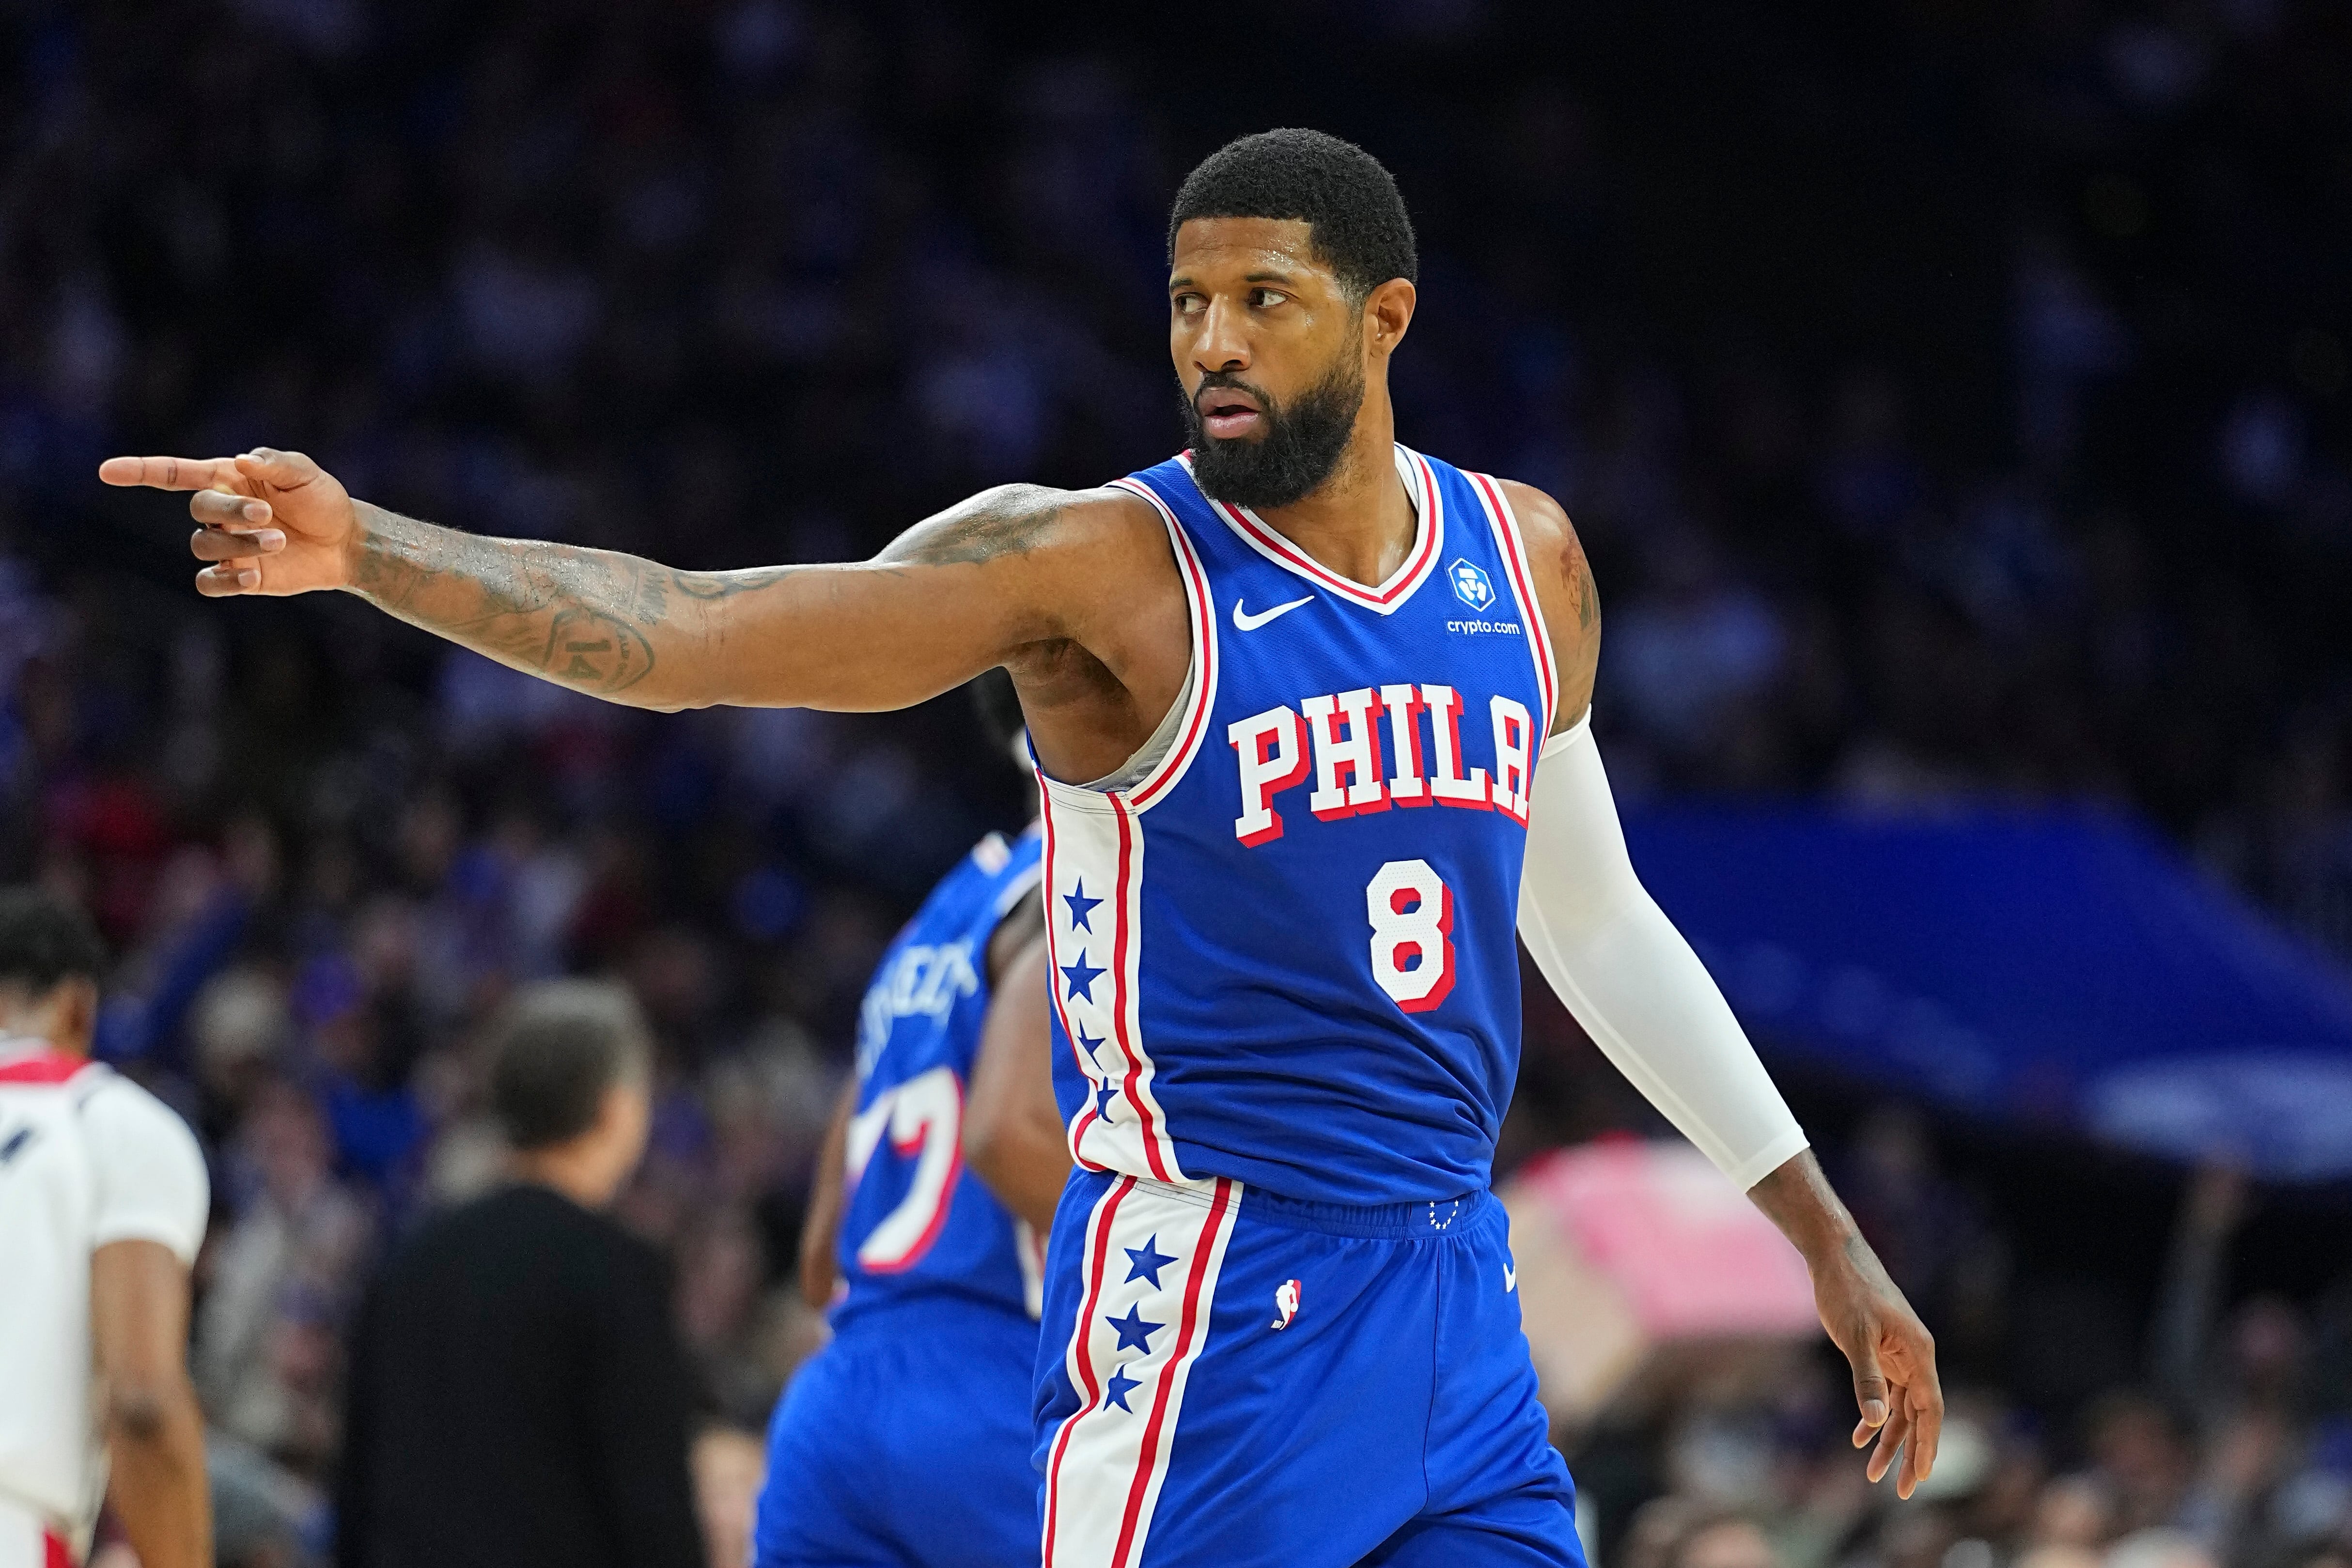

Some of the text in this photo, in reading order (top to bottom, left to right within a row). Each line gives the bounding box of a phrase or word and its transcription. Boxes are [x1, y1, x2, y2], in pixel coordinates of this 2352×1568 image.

[1447, 619, 1521, 635] crypto.com
[1228, 683, 1534, 848] PHILA
[1366, 858, 1456, 1014] 8
